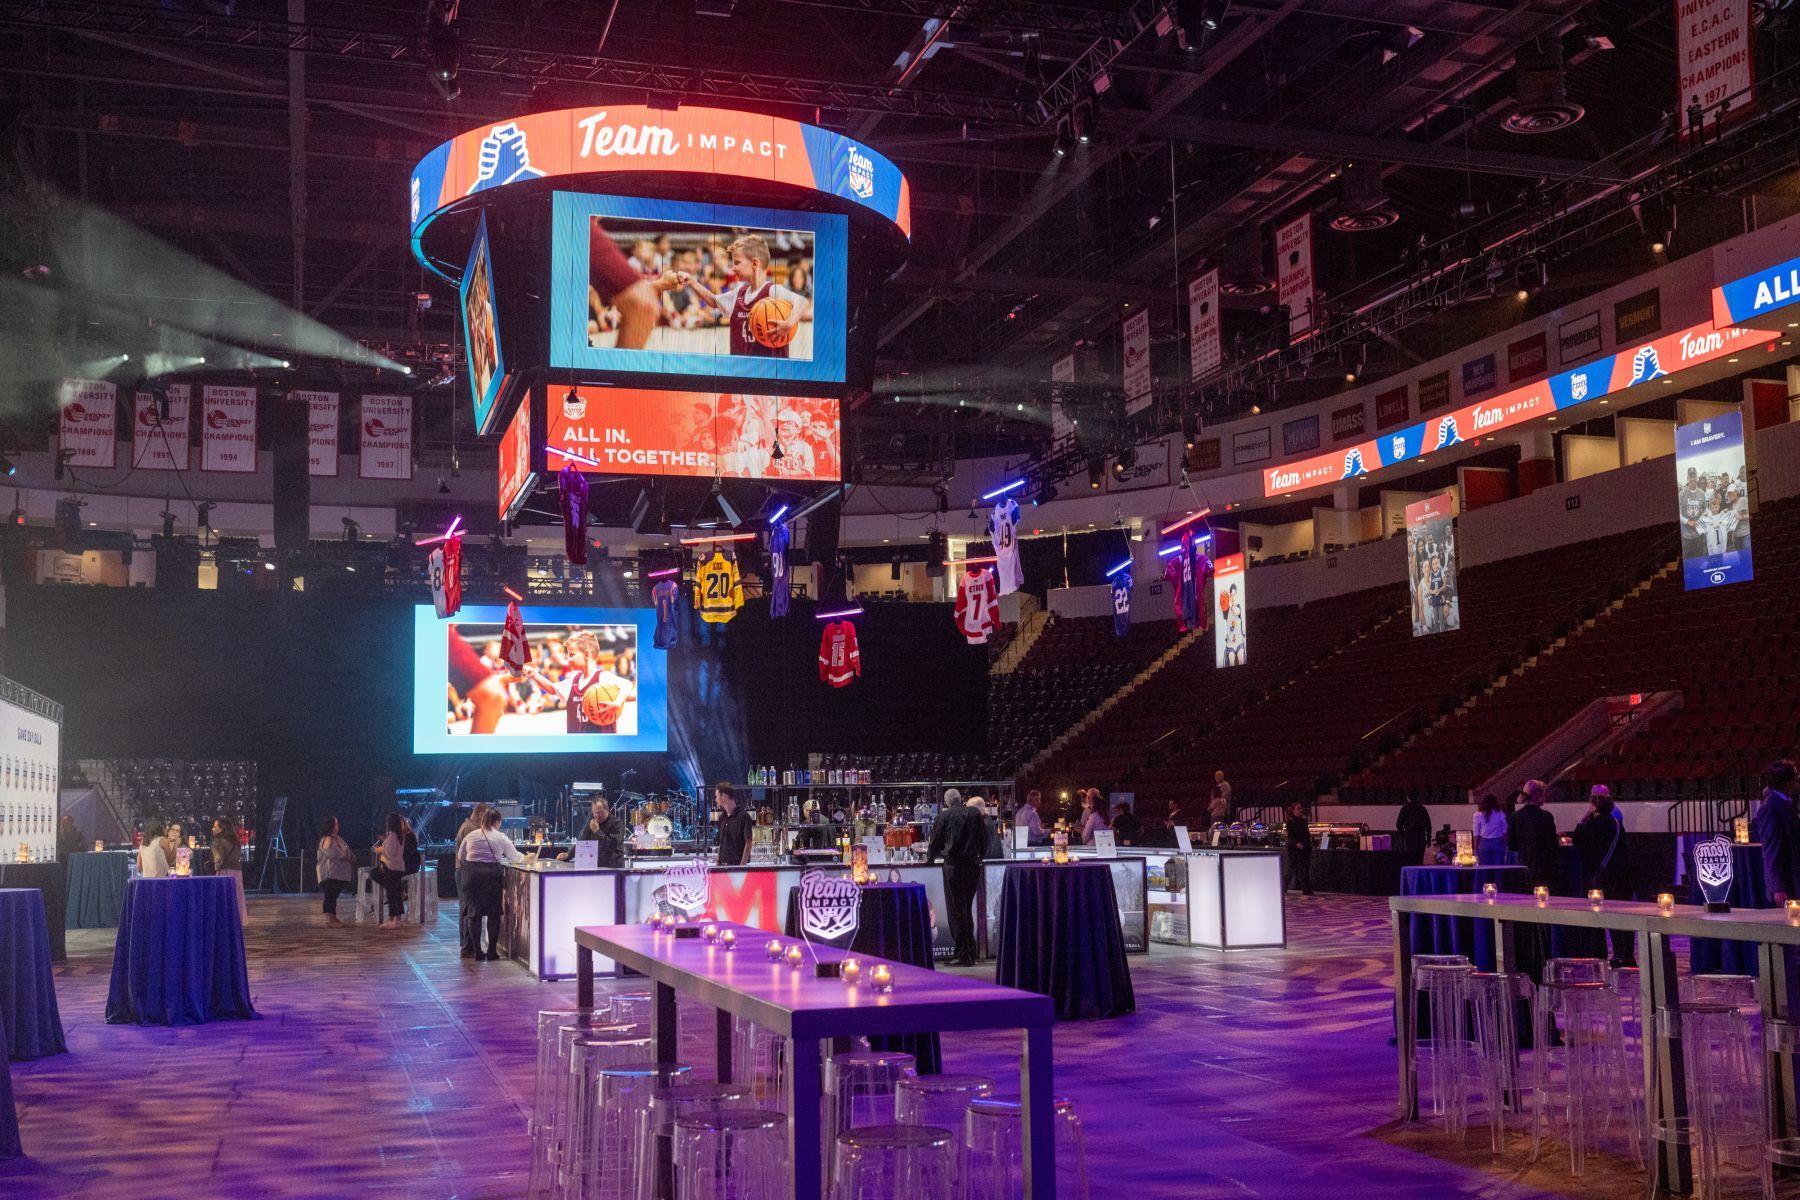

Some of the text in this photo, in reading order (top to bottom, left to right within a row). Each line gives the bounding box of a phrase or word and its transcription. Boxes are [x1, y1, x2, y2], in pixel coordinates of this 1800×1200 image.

[1691, 7, 1734, 37] E.C.A.C.
[1689, 28, 1739, 63] EASTERN
[1682, 49, 1747, 90] CHAMPIONS
[1705, 84, 1727, 104] 1977
[578, 112, 788, 160] Team IMPACT
[848, 147, 873, 172] Team
[1281, 222, 1304, 241] BOSTON
[1277, 230, 1309, 254] UNIVERSITY
[1282, 267, 1306, 287] BEANPOT
[1754, 269, 1800, 310] ALL
[1561, 325, 1600, 351] PROVIDENCE
[1680, 331, 1723, 361] Team
[205, 397, 256, 407] UNIVERSITY
[212, 389, 246, 397] BOSTON
[370, 398, 403, 407] BOSTON
[308, 402, 337, 411] ERSITY
[363, 407, 411, 415] UNIVERSITY
[1473, 397, 1540, 430] Team IMPACT
[62, 427, 113, 436] CHAMPIONS
[1332, 412, 1364, 434] UMASS
[136, 430, 187, 439] CHAMPIONS
[204, 433, 255, 442] CHAMPIONS
[309, 438, 337, 446] PIONS
[563, 426, 631, 443] ALL IN.
[363, 441, 410, 449] CHAMPIONS
[220, 453, 238, 461] 1994
[563, 447, 716, 467] ALL TOGETHER.
[1270, 465, 1334, 490] Team IMPACT
[706, 572, 730, 600] 20
[972, 593, 983, 621] 7
[803, 871, 857, 899] Team
[806, 898, 856, 908] IMPACT
